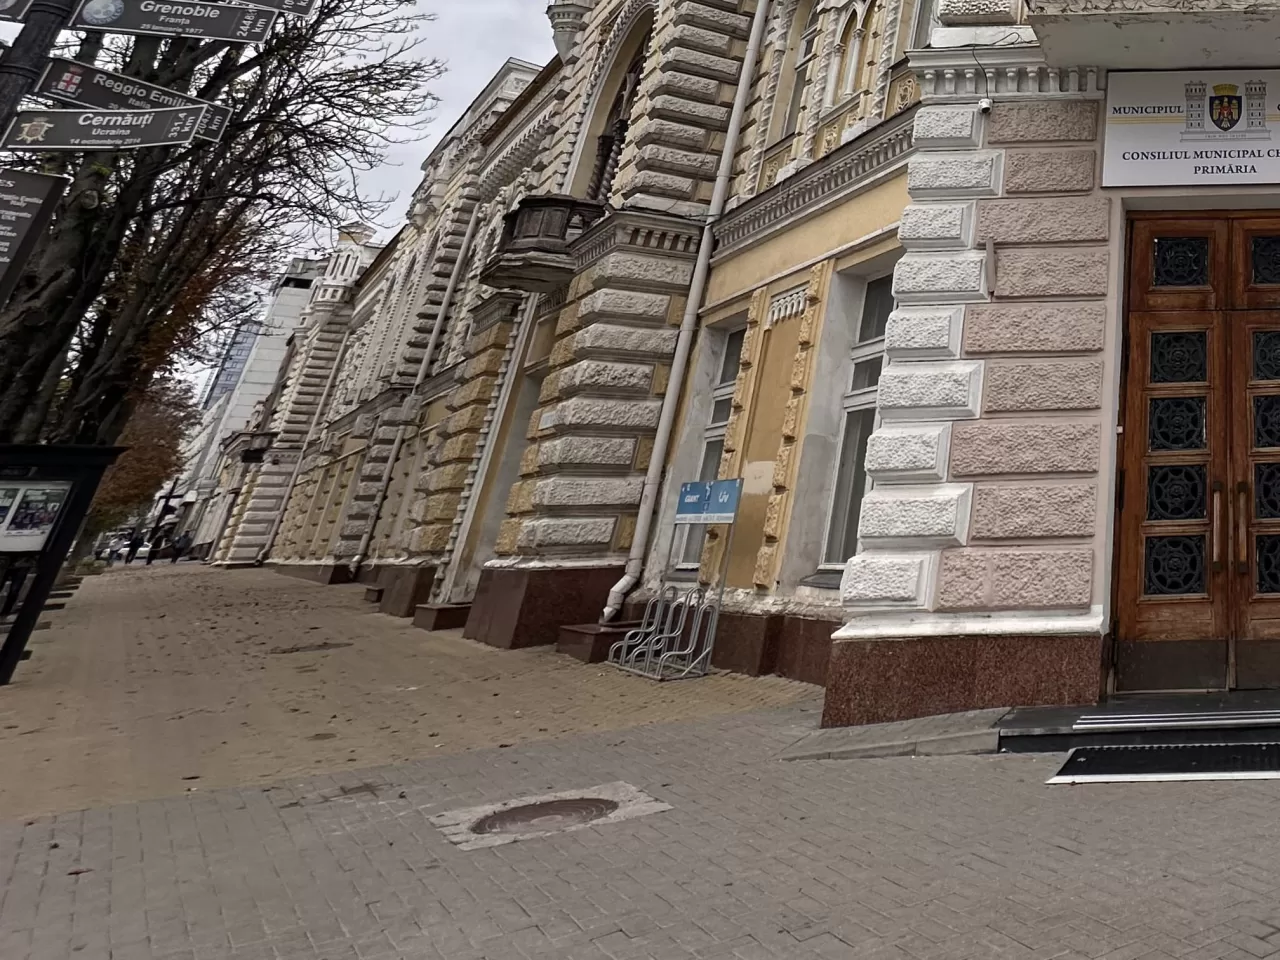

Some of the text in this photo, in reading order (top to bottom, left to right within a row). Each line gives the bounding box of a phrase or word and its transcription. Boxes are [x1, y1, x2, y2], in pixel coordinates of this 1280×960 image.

[140, 0, 220, 18] Grenoble
[251, 19, 267, 32] km
[93, 73, 147, 97] Reggio
[128, 97, 151, 109] Italia
[1112, 105, 1184, 115] MUNICIPIUL
[78, 112, 155, 128] Cernăuți
[168, 112, 187, 138] 331.4
[180, 116, 196, 132] km
[208, 115, 223, 130] km
[91, 128, 130, 136] Ucraina
[1122, 150, 1191, 161] CONSILIUL
[1193, 149, 1265, 159] MUNICIPAL
[1193, 163, 1257, 175] PRIMĂRIA
